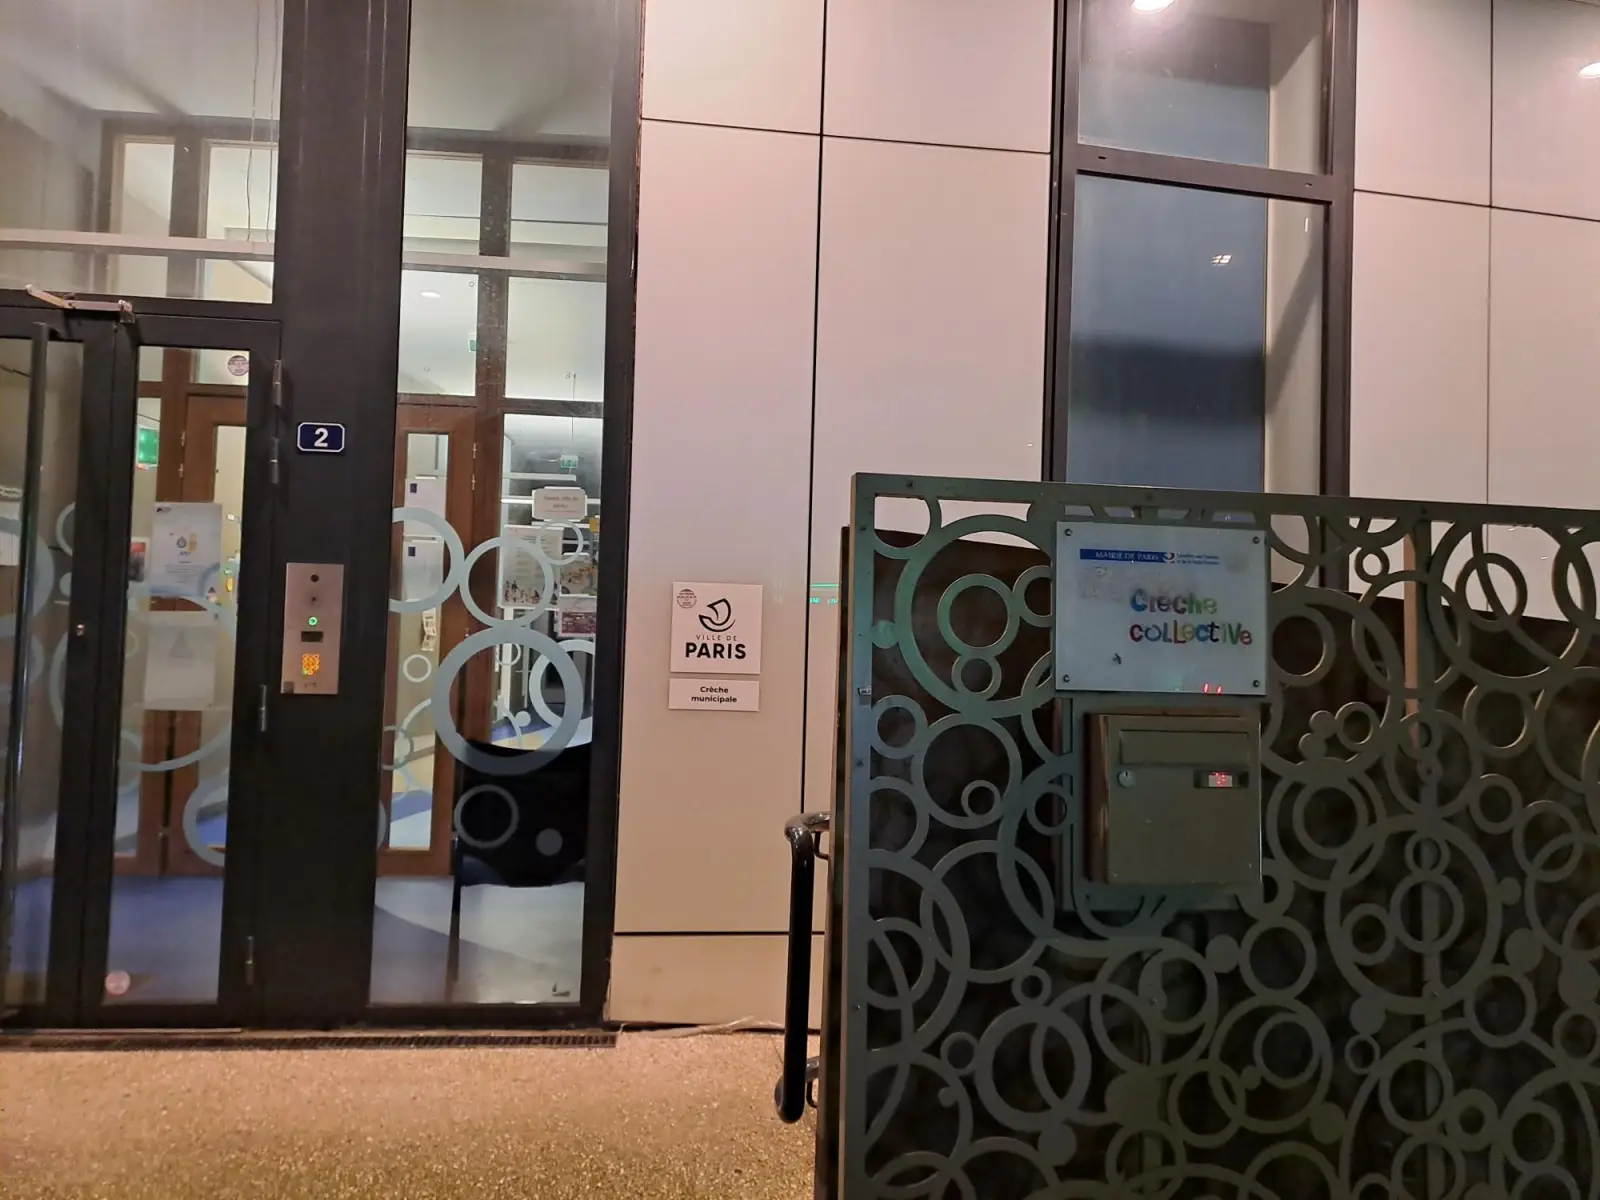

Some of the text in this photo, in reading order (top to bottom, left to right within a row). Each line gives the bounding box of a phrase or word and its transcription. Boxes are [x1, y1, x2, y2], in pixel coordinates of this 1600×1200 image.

[314, 428, 328, 447] 2
[685, 642, 746, 659] PARIS
[700, 686, 729, 694] Crèche
[691, 695, 737, 703] municipale
